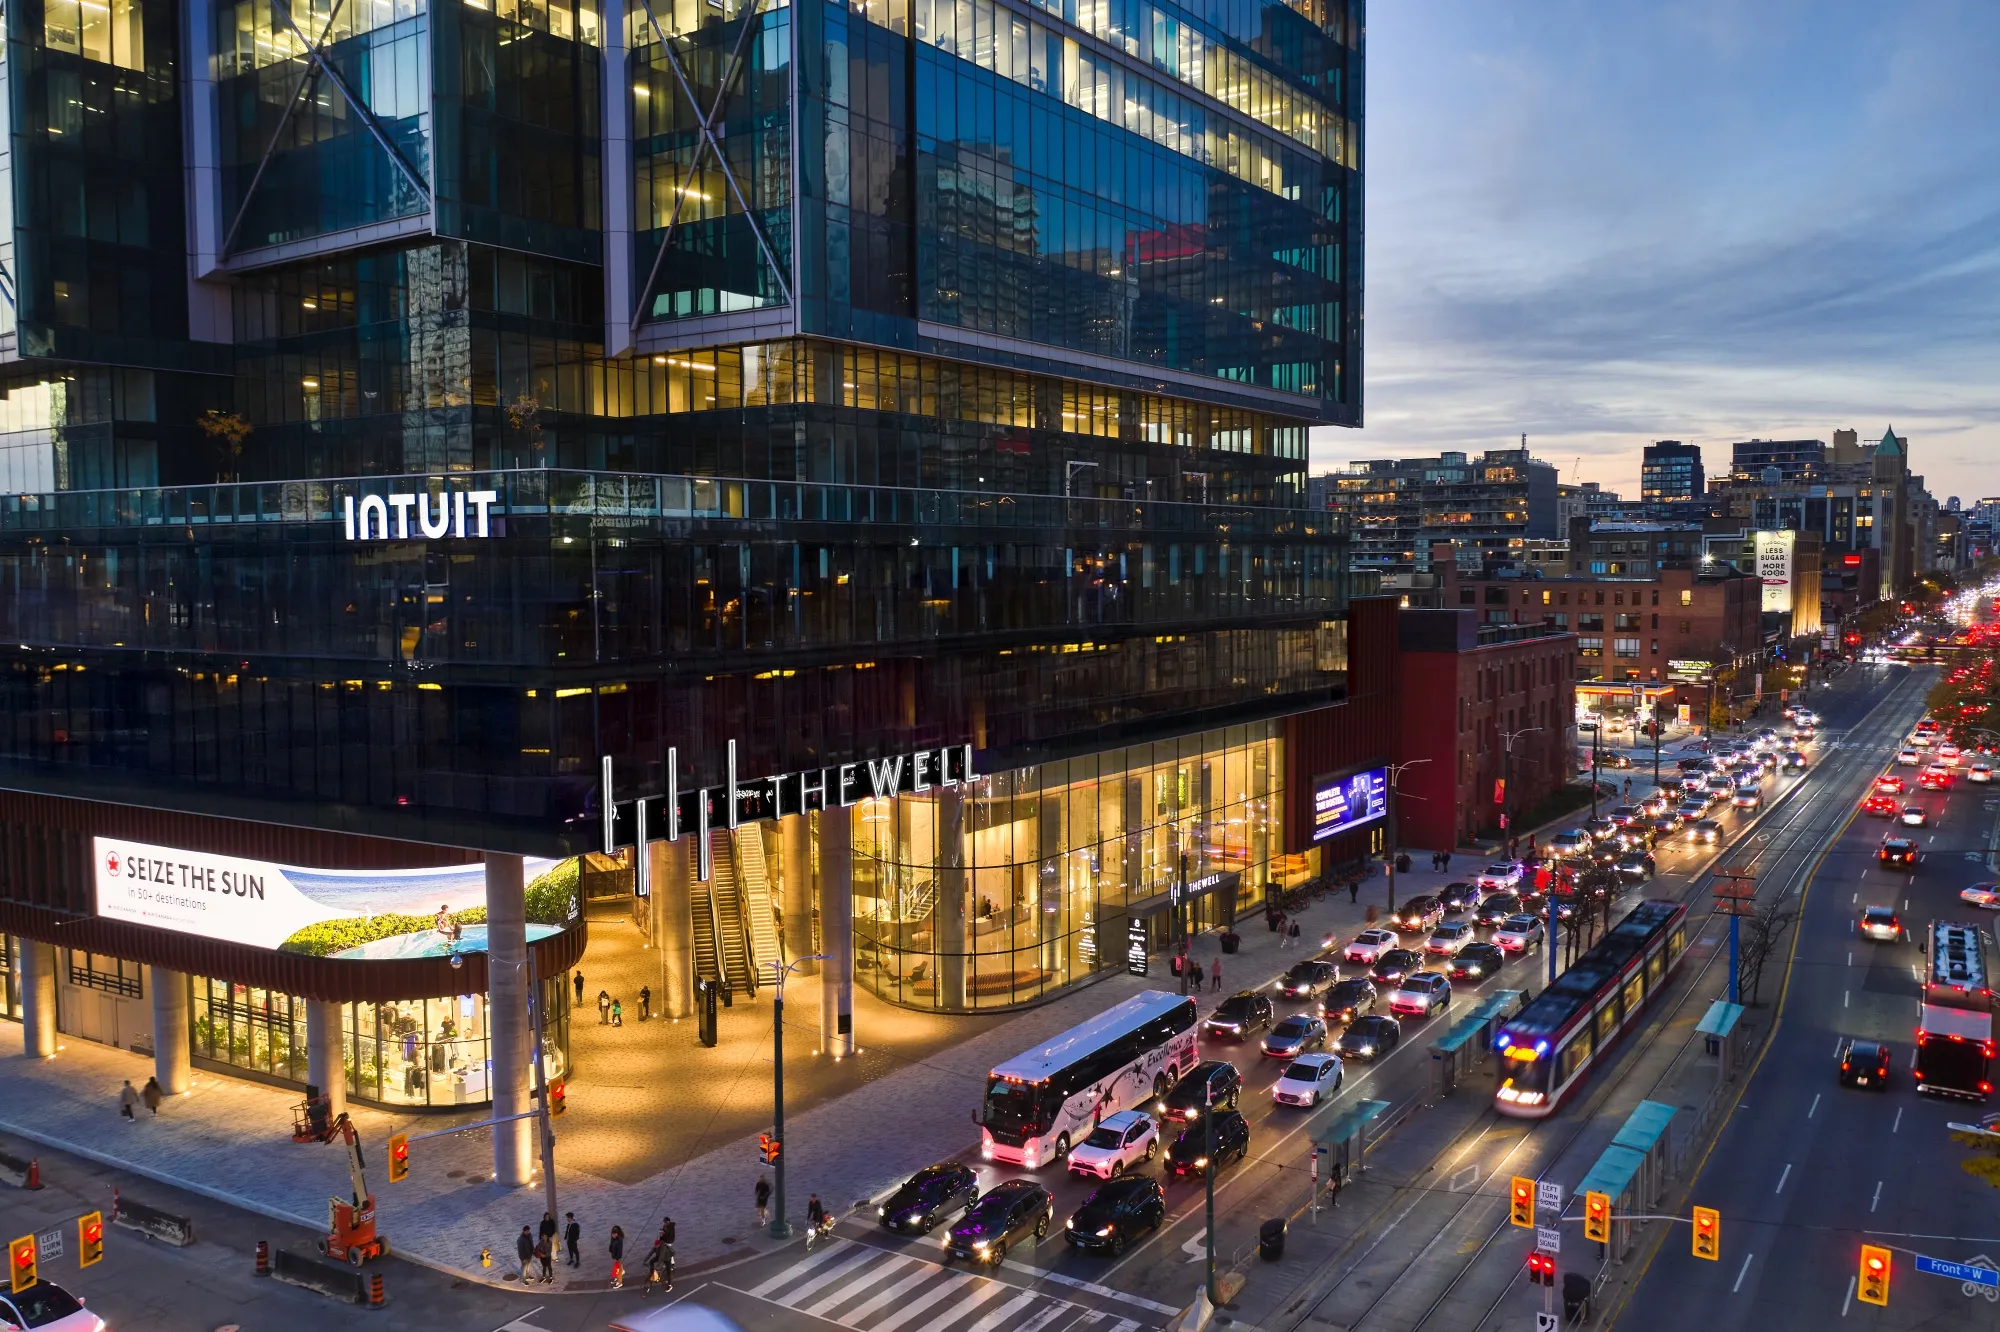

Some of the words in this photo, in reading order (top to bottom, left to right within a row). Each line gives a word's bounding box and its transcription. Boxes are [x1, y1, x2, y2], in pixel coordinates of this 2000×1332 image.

[345, 490, 497, 540] INTUIT
[127, 856, 175, 886] SEIZE
[178, 863, 216, 893] THE
[221, 870, 265, 901] SUN
[137, 887, 153, 901] 50+
[155, 891, 207, 911] destinations
[1134, 919, 1141, 928] 8
[1542, 1184, 1558, 1193] LEFT
[1541, 1191, 1559, 1201] TURN
[1540, 1198, 1559, 1209] SIGNAL
[41, 1232, 59, 1244] LEFT
[1538, 1230, 1559, 1241] TRANSIT
[42, 1240, 61, 1252] TURN
[1539, 1239, 1558, 1250] SIGNAL
[41, 1249, 61, 1261] SIGNAL
[1931, 1260, 1961, 1276] Front
[1972, 1268, 1983, 1280] W
